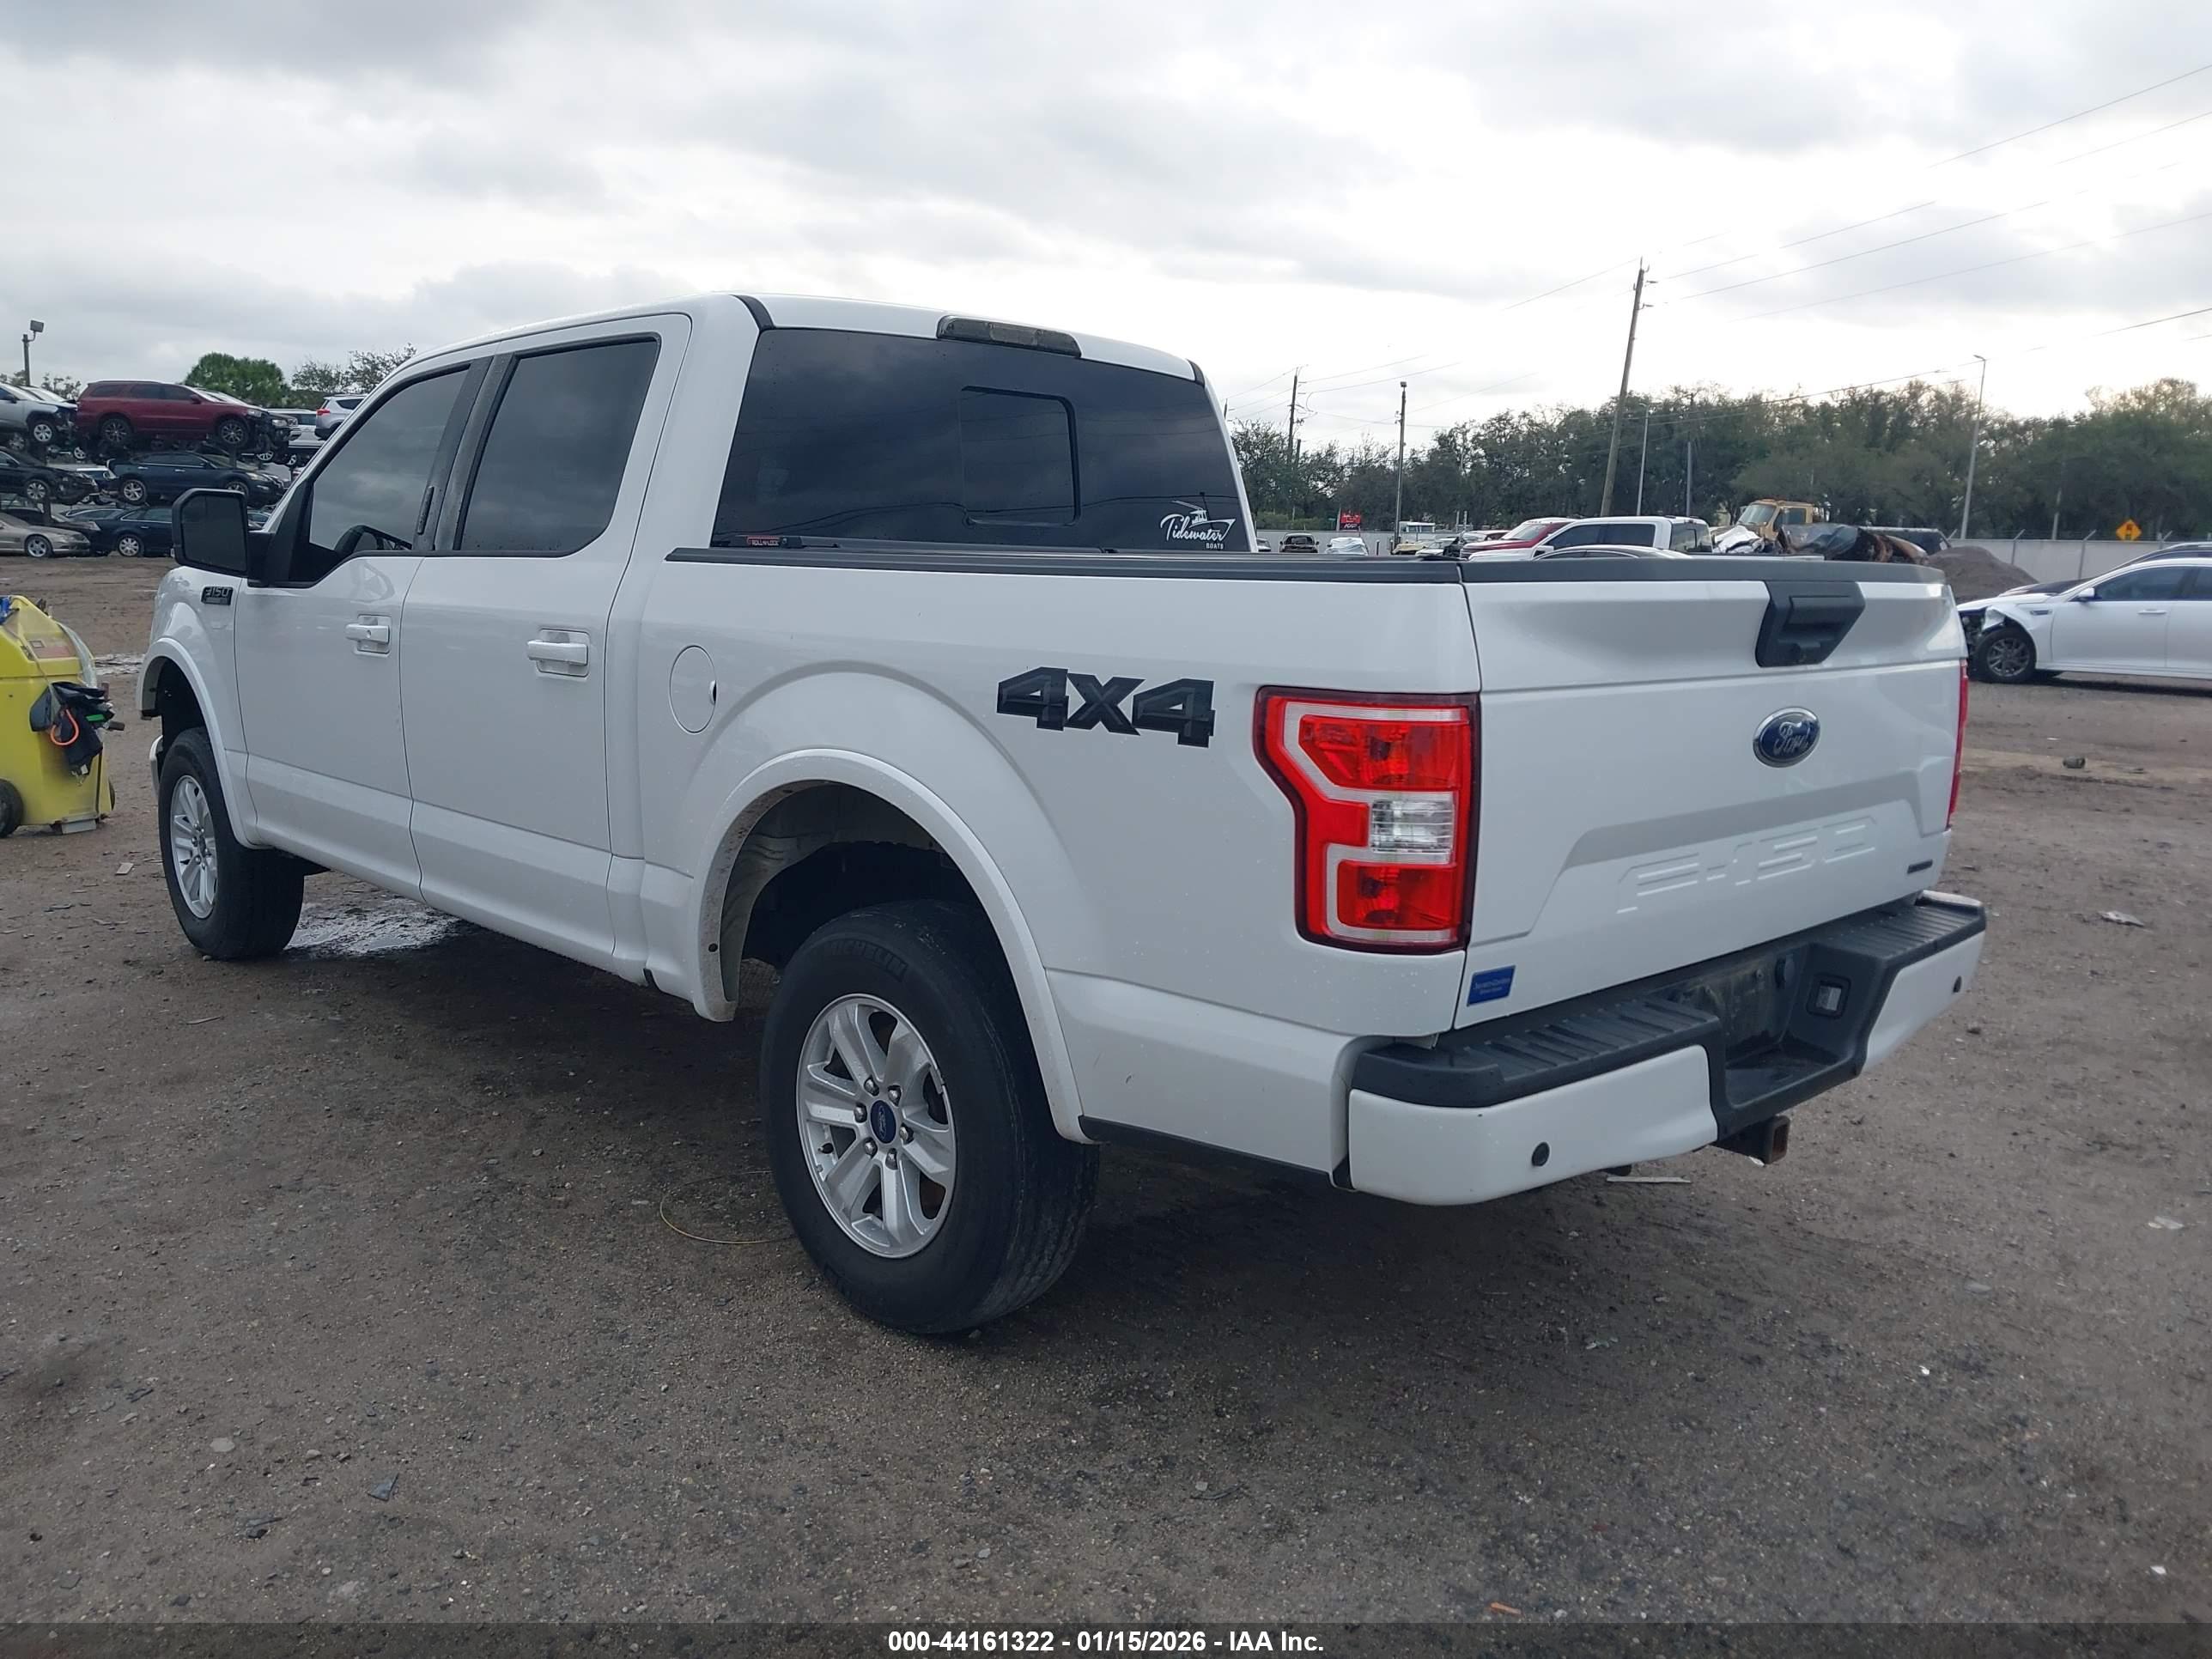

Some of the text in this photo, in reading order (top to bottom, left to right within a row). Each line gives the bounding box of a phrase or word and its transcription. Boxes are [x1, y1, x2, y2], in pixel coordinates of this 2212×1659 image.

[1160, 514, 1225, 542] Tidewater
[1773, 721, 1811, 756] Ford
[1617, 814, 1878, 914] F-150
